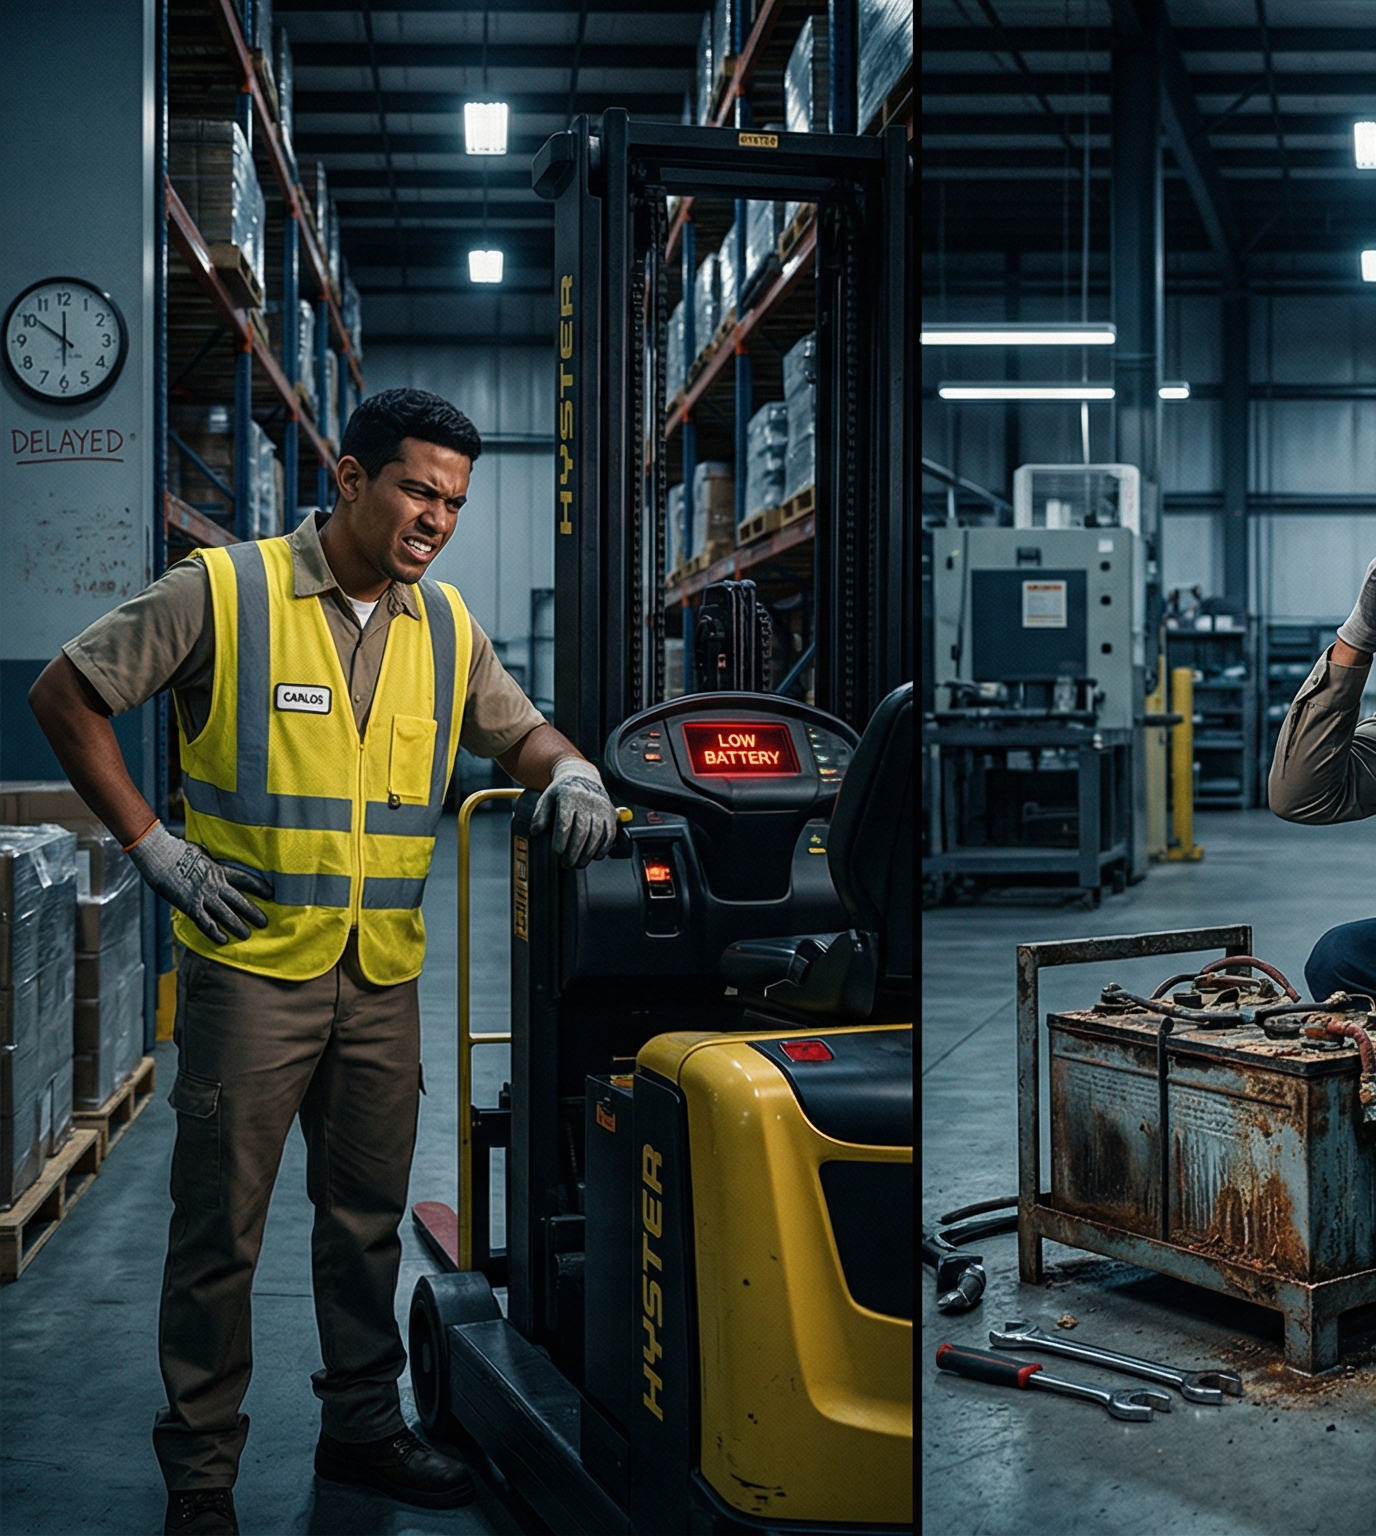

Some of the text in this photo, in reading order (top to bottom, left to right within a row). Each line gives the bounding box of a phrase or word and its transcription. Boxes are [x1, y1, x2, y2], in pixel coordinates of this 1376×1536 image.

[38, 298, 48, 312] 11
[57, 292, 71, 306] 12
[83, 298, 88, 312] 1
[22, 314, 37, 328] 10
[95, 313, 105, 327] 2
[16, 334, 27, 348] 9
[101, 333, 111, 348] 3
[23, 355, 33, 370] 8
[95, 355, 105, 368] 4
[40, 370, 49, 385] 7
[59, 374, 69, 390] 6
[80, 370, 90, 385] 5
[559, 274, 573, 535] HYSTER
[11, 429, 124, 455] DELAYED
[718, 734, 755, 748] LOW
[704, 751, 779, 765] BATTERY
[642, 1143, 663, 1422] HYSTER
